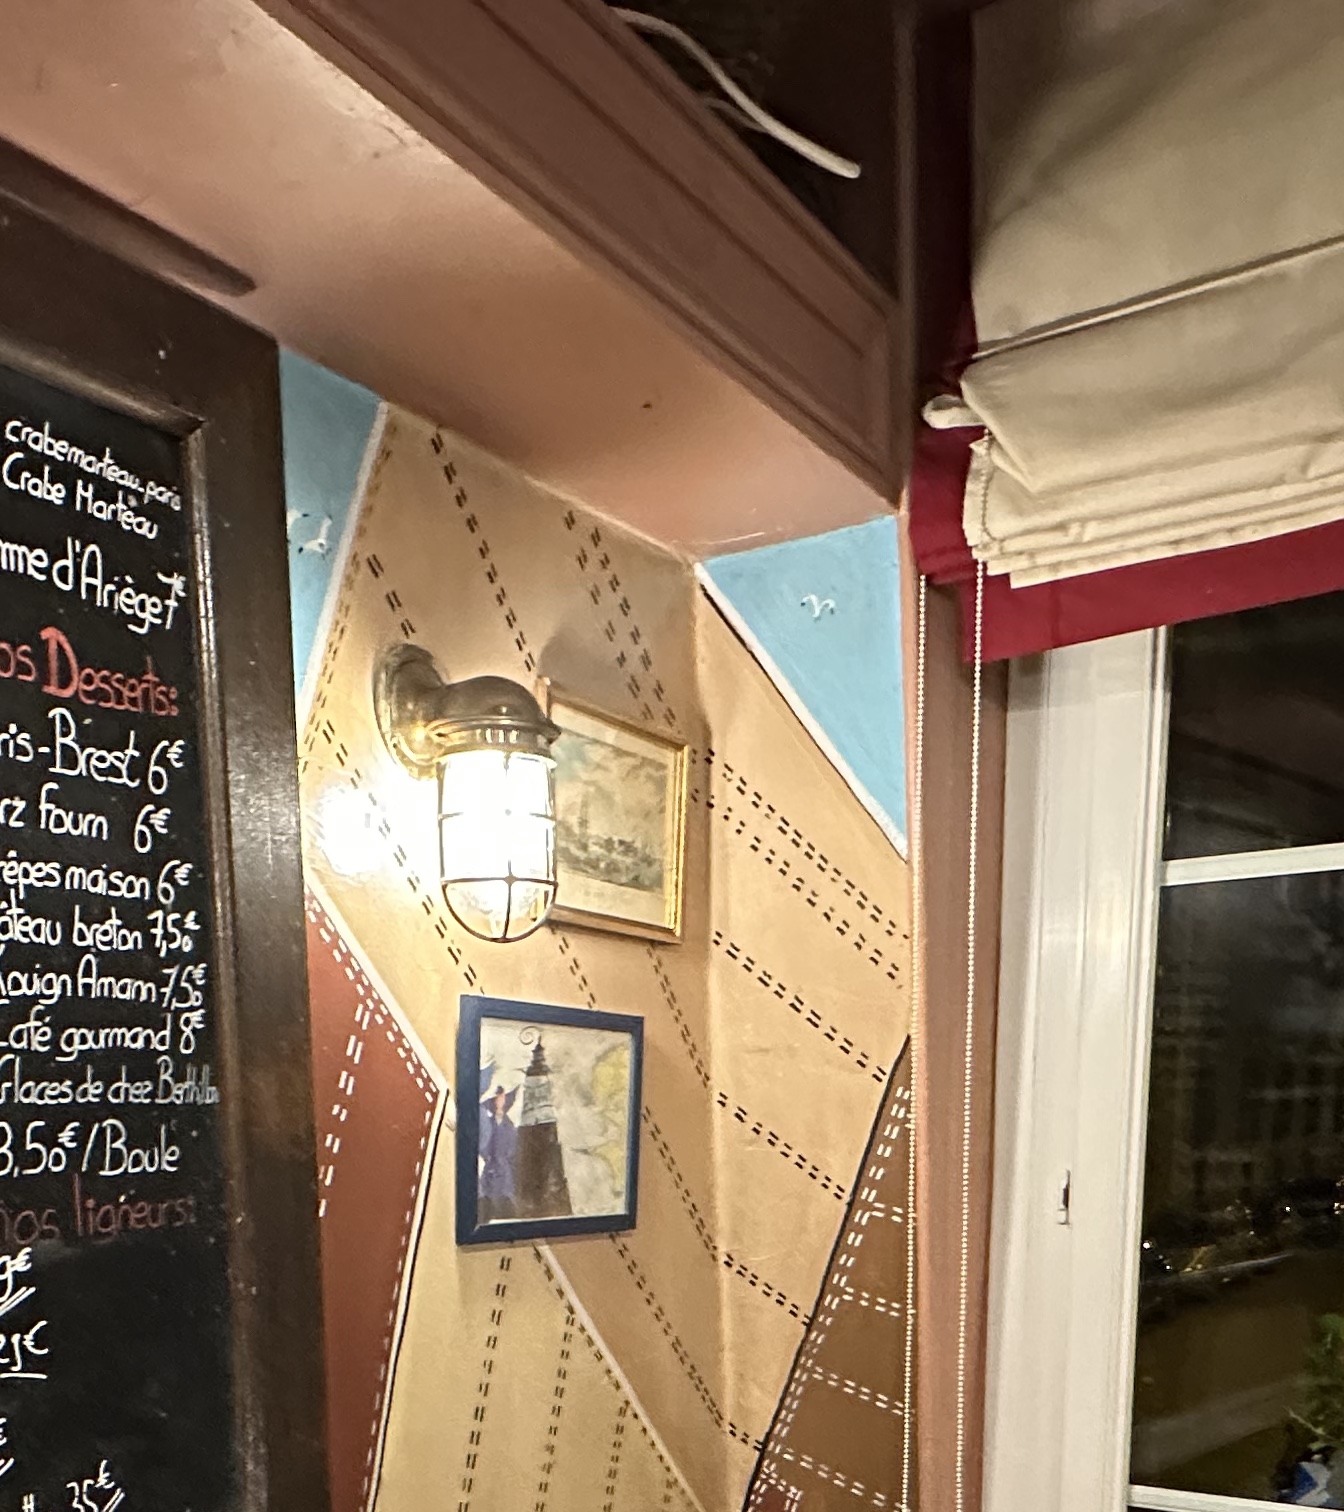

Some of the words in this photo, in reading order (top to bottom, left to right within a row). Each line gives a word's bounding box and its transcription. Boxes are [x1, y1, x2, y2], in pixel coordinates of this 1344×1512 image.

[1, 450, 67, 507] Crabe
[75, 478, 159, 541] Marteau
[147, 739, 186, 796] 6€
[134, 804, 172, 854] 6€
[64, 864, 152, 901] maison
[157, 860, 193, 906] 6€
[72, 904, 143, 952] breton
[55, 1012, 172, 1062] gourmand
[178, 1009, 208, 1055] 8€
[75, 1064, 105, 1105] de
[107, 1064, 154, 1105] chez
